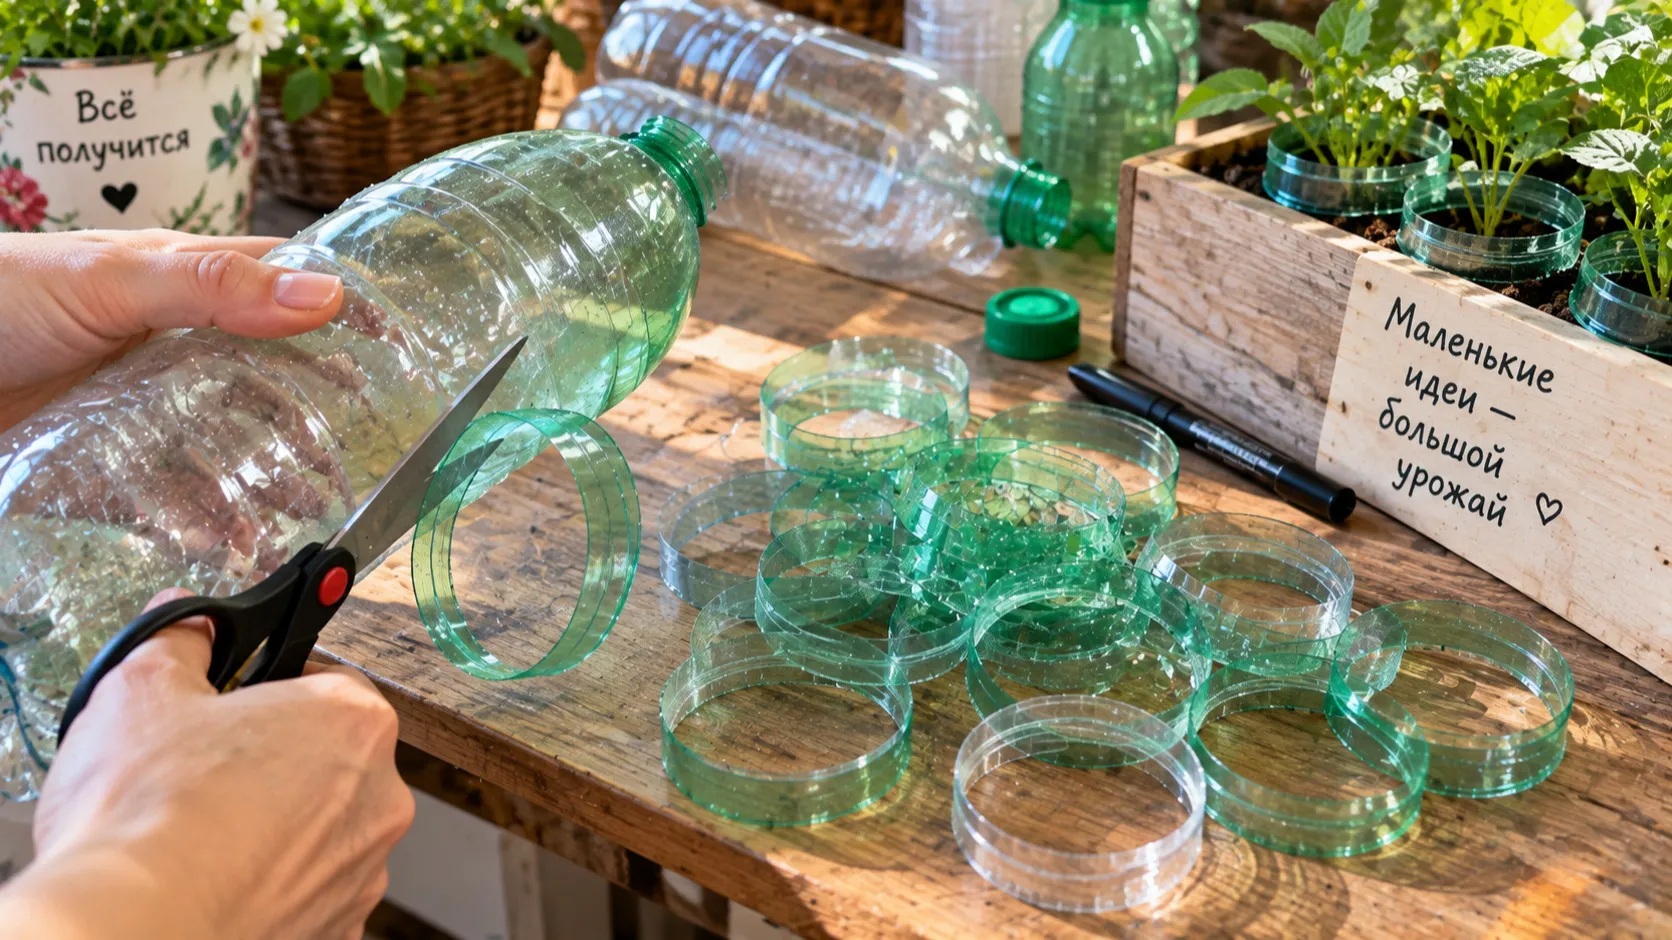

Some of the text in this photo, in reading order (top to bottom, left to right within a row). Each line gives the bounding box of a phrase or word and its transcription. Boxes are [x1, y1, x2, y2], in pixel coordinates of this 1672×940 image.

[76, 88, 137, 124] Всё
[37, 128, 190, 172] получится
[1384, 296, 1555, 393] Маленькие
[1404, 366, 1478, 414] идеи
[1379, 397, 1506, 479] большой
[1391, 458, 1508, 527] урожай
